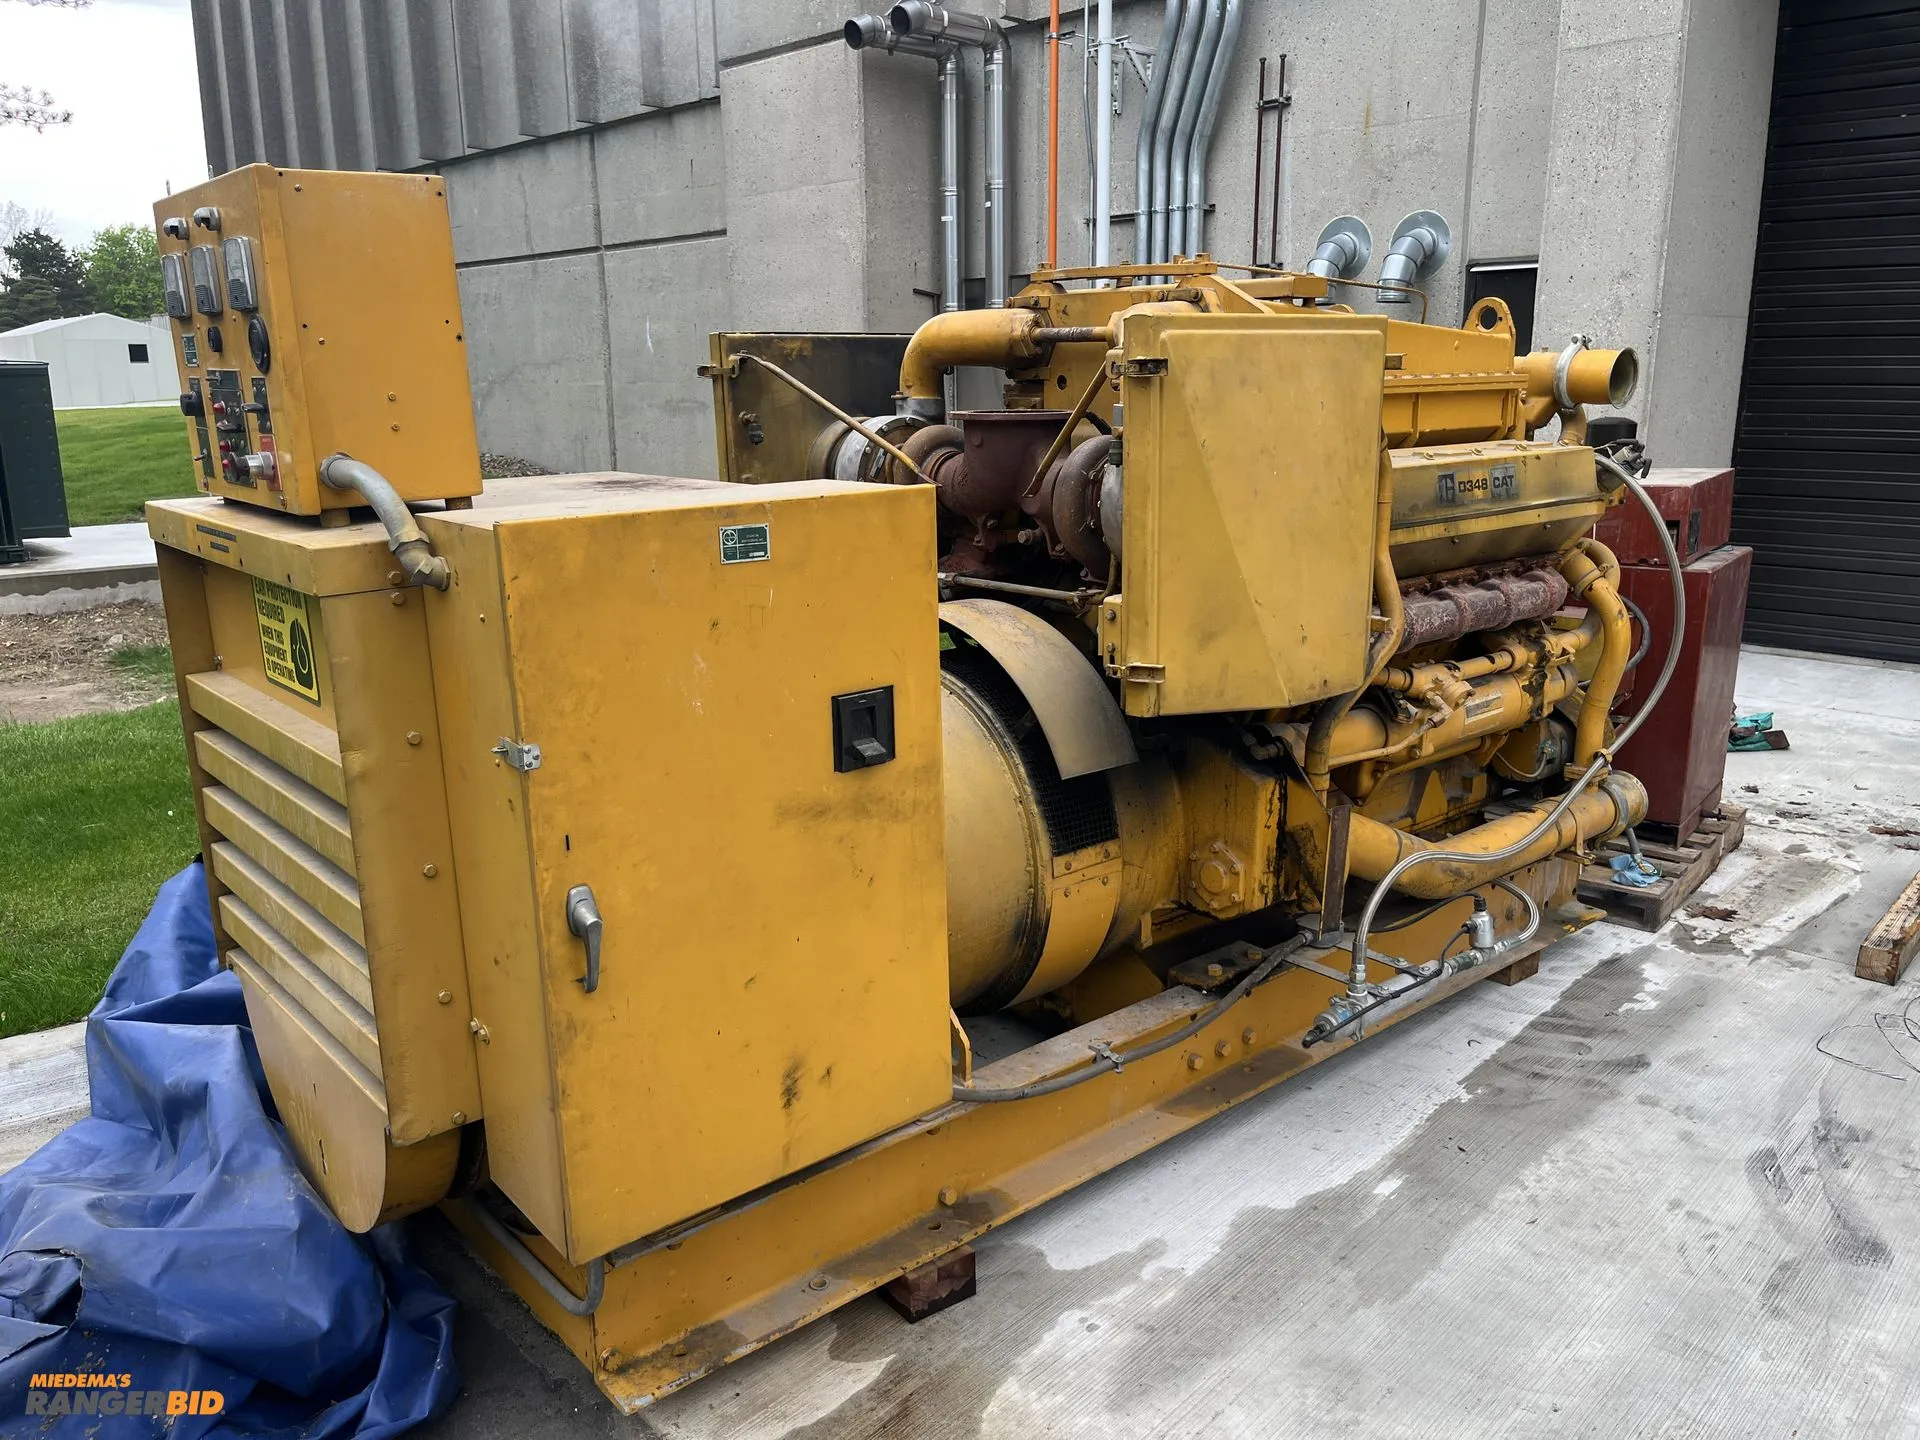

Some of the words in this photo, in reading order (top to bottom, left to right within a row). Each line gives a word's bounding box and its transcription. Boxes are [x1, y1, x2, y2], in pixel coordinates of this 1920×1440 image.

[1458, 478, 1488, 493] D348
[1493, 475, 1514, 488] CAT
[257, 598, 285, 624] REQUIRED
[273, 629, 285, 645] THIS
[264, 640, 288, 663] EQUIPMENT
[271, 661, 296, 683] OPERATING
